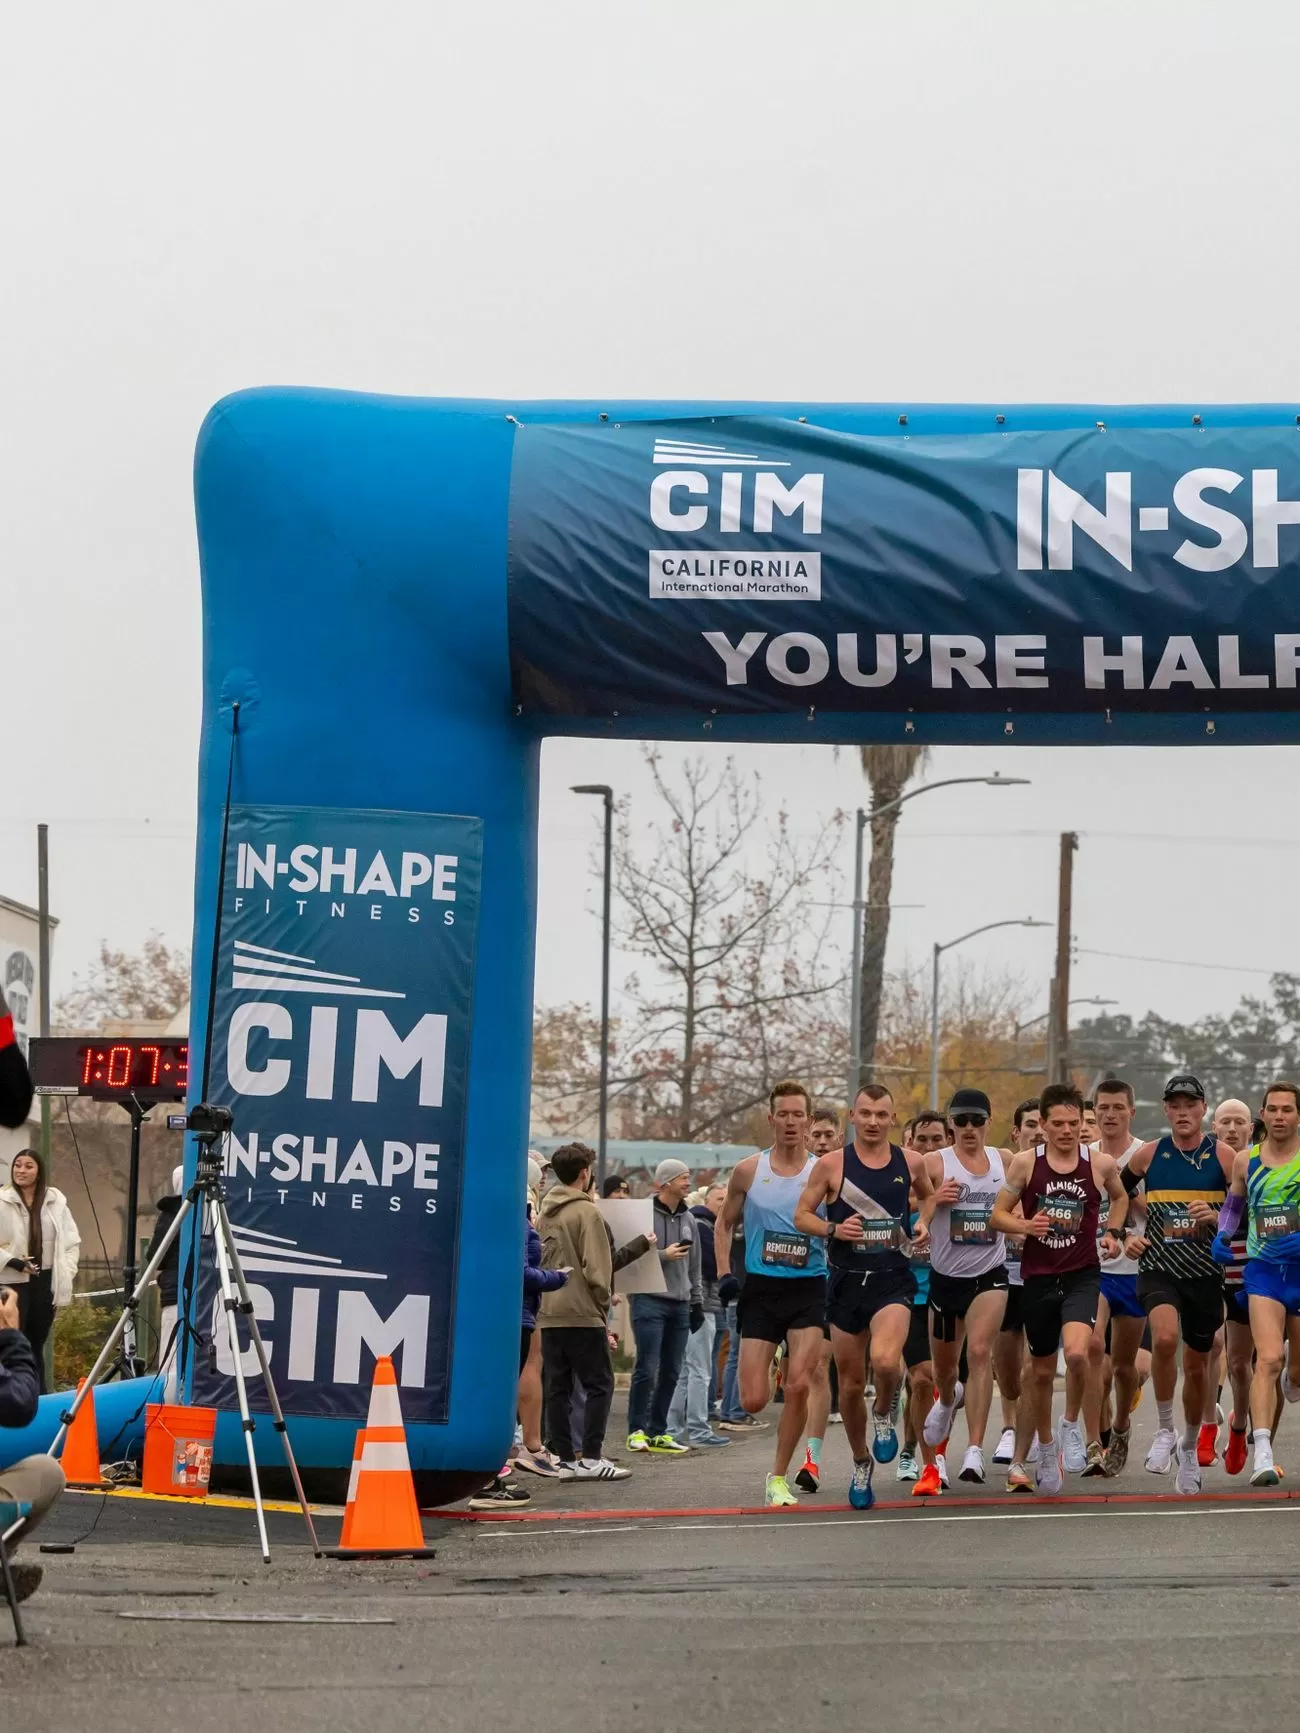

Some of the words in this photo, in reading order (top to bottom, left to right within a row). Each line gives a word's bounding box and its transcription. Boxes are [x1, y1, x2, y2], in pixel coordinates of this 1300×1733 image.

[650, 470, 825, 535] CIM
[662, 558, 809, 578] CALIFORNIA
[661, 581, 744, 593] International
[746, 582, 809, 594] Marathon
[701, 631, 1049, 689] YOU’RE
[236, 842, 459, 901] IN-SHAPE
[235, 897, 455, 925] FITNESS
[227, 1001, 448, 1107] CIM
[1046, 1181, 1087, 1200] ALMIGHTY
[1047, 1207, 1072, 1220] 466
[1264, 1216, 1287, 1228] PACER
[963, 1221, 986, 1231] DOUD
[1173, 1218, 1197, 1229] 367
[766, 1241, 808, 1257] REMILLARD
[1038, 1234, 1077, 1249] LMONDS
[212, 1282, 431, 1388] CIM
